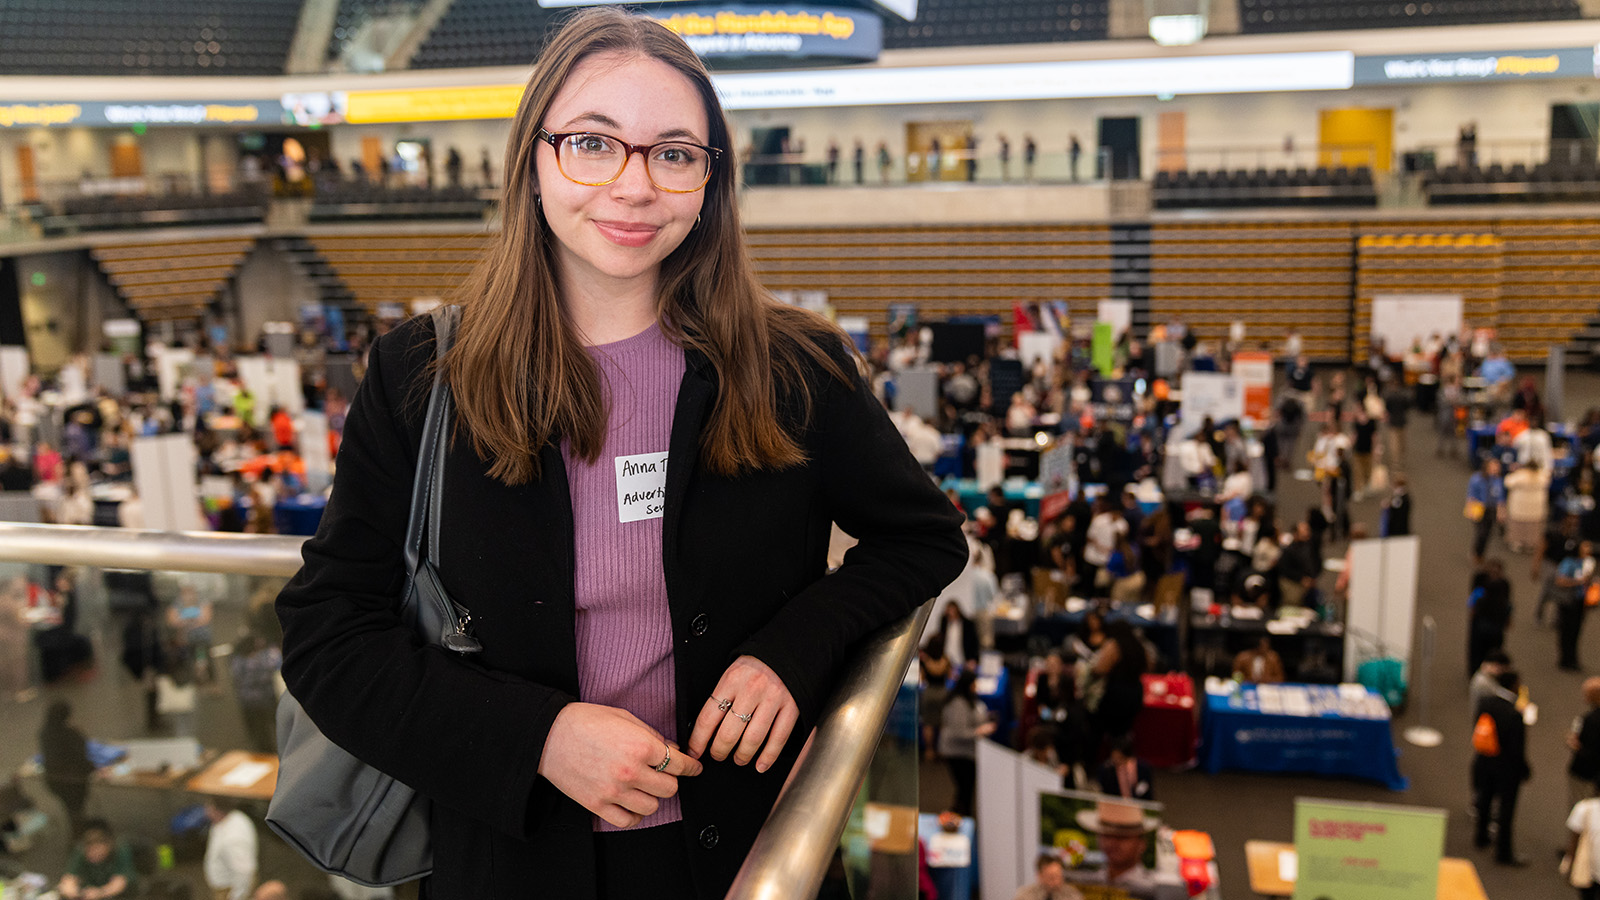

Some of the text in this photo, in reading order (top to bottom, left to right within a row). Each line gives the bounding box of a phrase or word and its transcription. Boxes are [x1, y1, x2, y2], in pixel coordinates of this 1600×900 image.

[716, 11, 821, 34] Handshake
[821, 12, 854, 38] App
[622, 460, 657, 477] Anna
